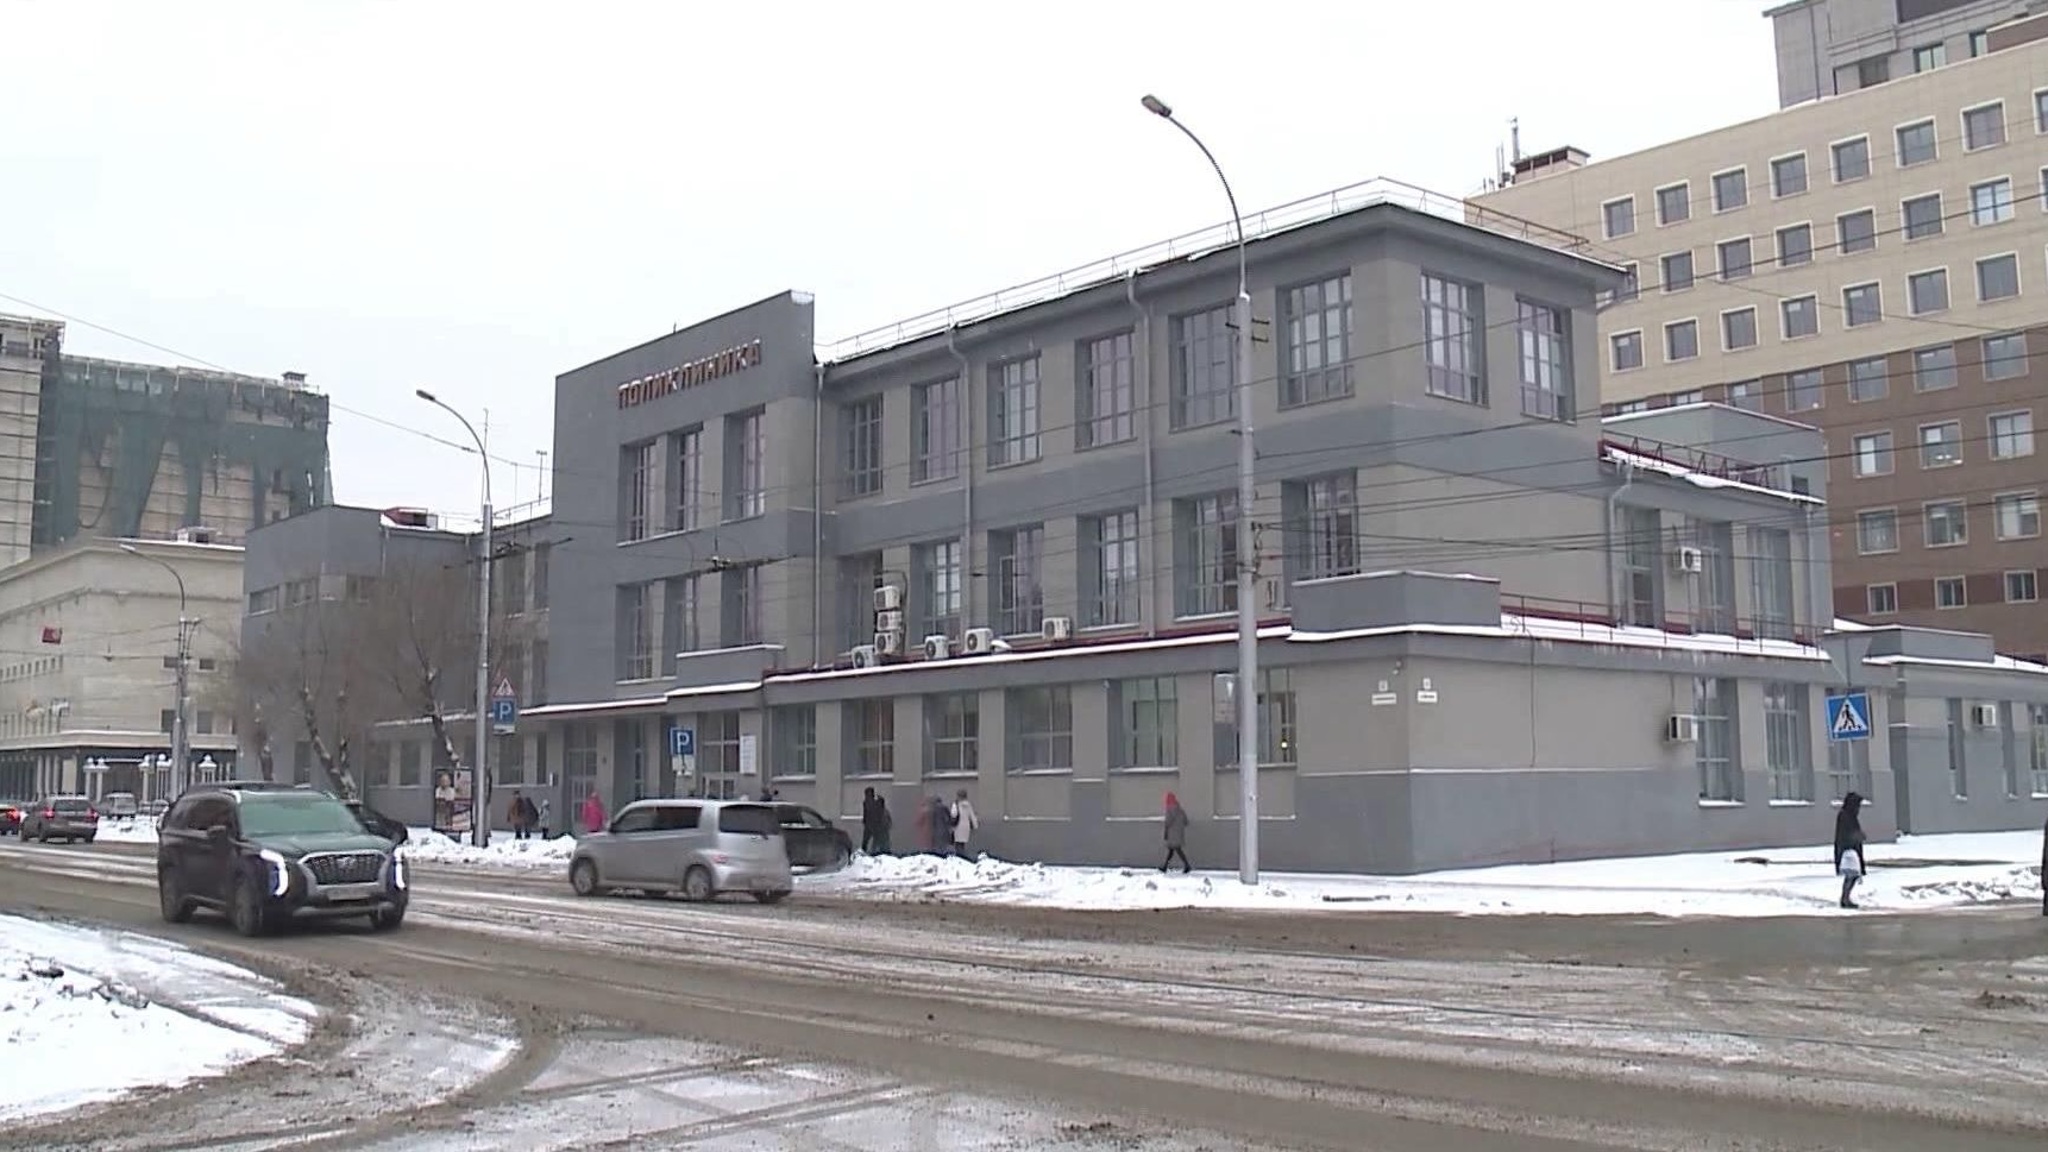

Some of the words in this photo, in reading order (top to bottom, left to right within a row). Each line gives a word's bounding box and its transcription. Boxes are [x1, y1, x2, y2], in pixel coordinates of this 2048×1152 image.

[618, 339, 761, 410] ПОЛИКЛИНИКА
[500, 702, 512, 720] P
[677, 732, 690, 754] P
